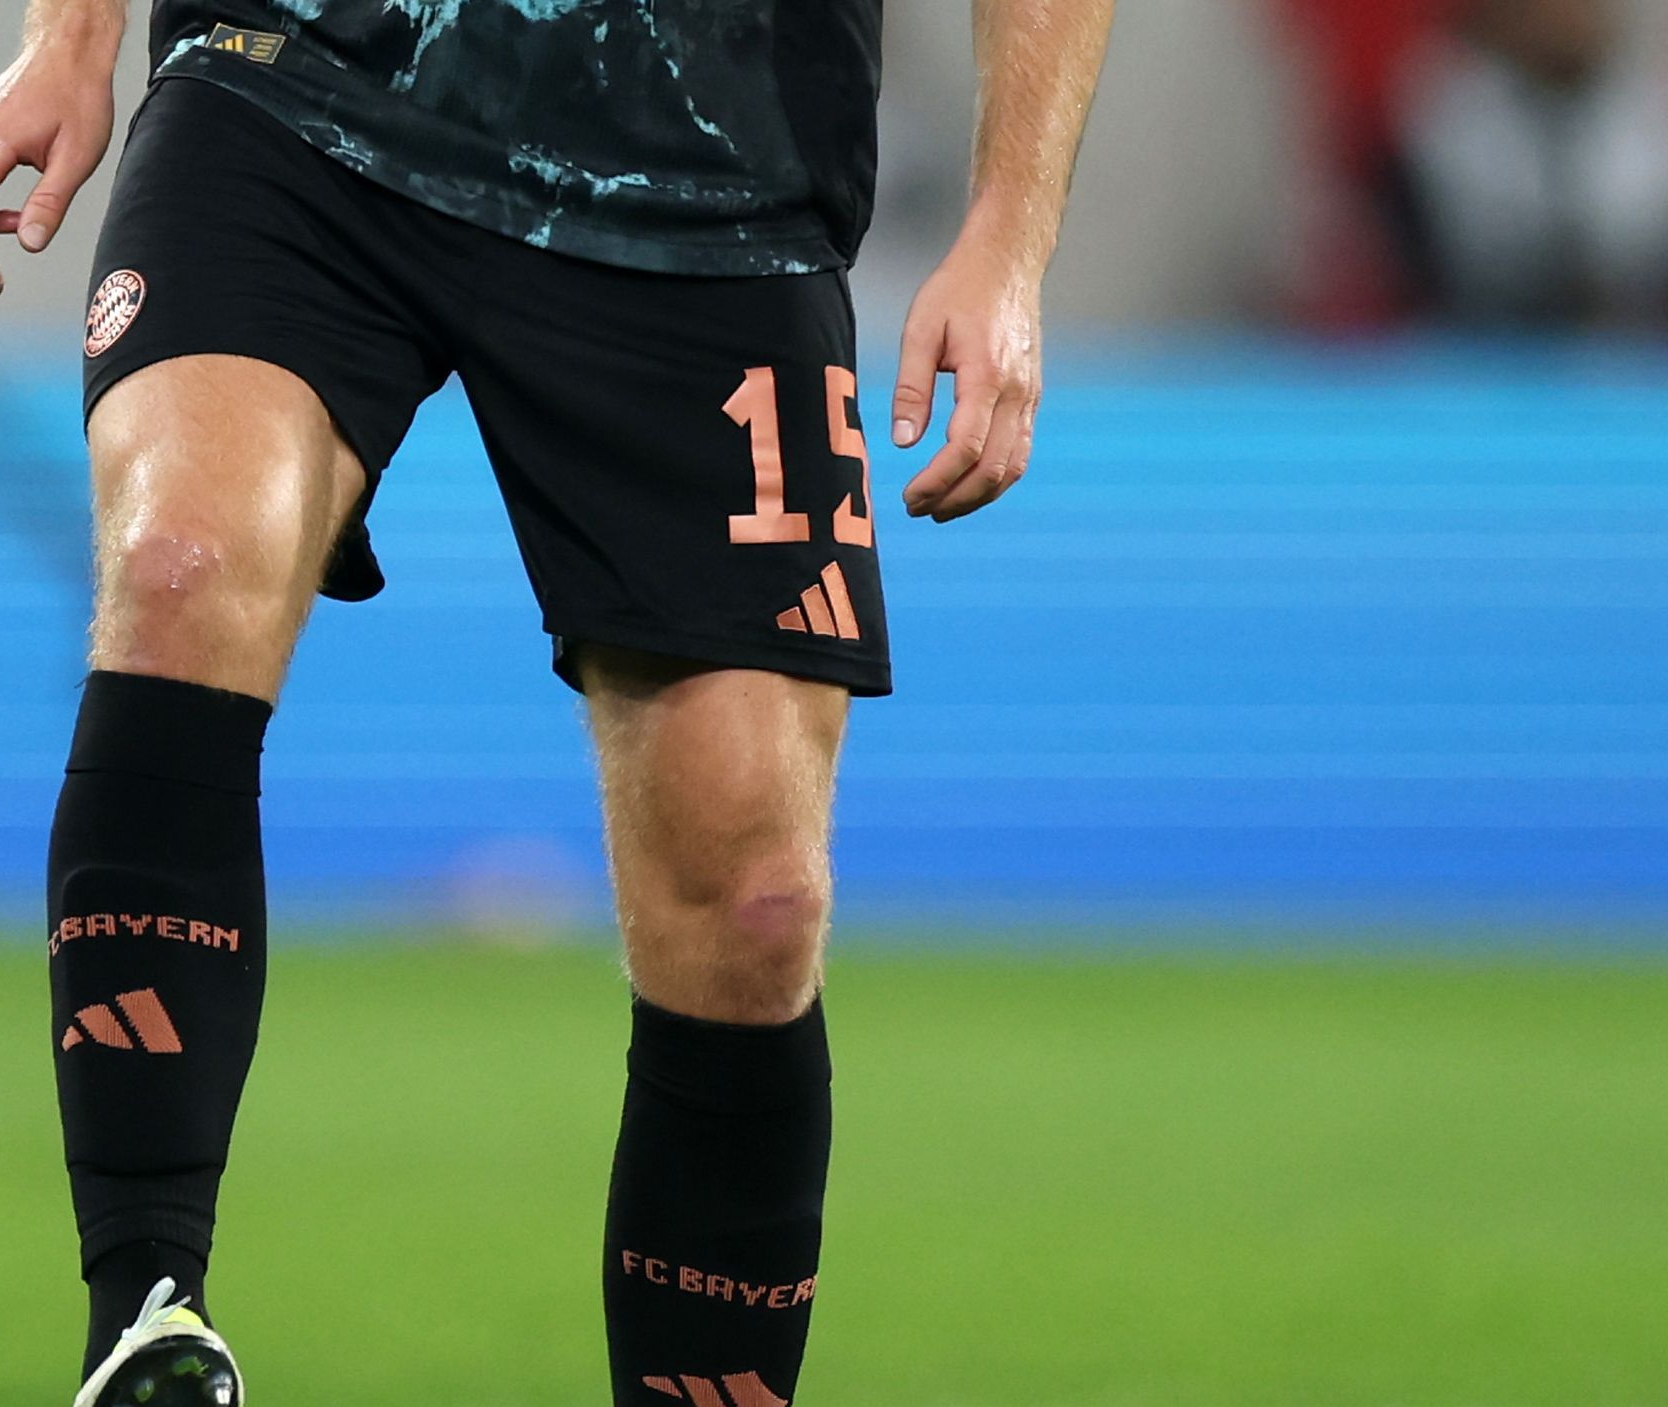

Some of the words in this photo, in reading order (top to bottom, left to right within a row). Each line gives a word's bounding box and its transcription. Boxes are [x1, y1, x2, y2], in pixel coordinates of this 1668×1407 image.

[721, 364, 873, 548] 15
[59, 913, 240, 953] BAYERN
[621, 1249, 669, 1285] FC
[678, 1264, 818, 1309] BAYER
